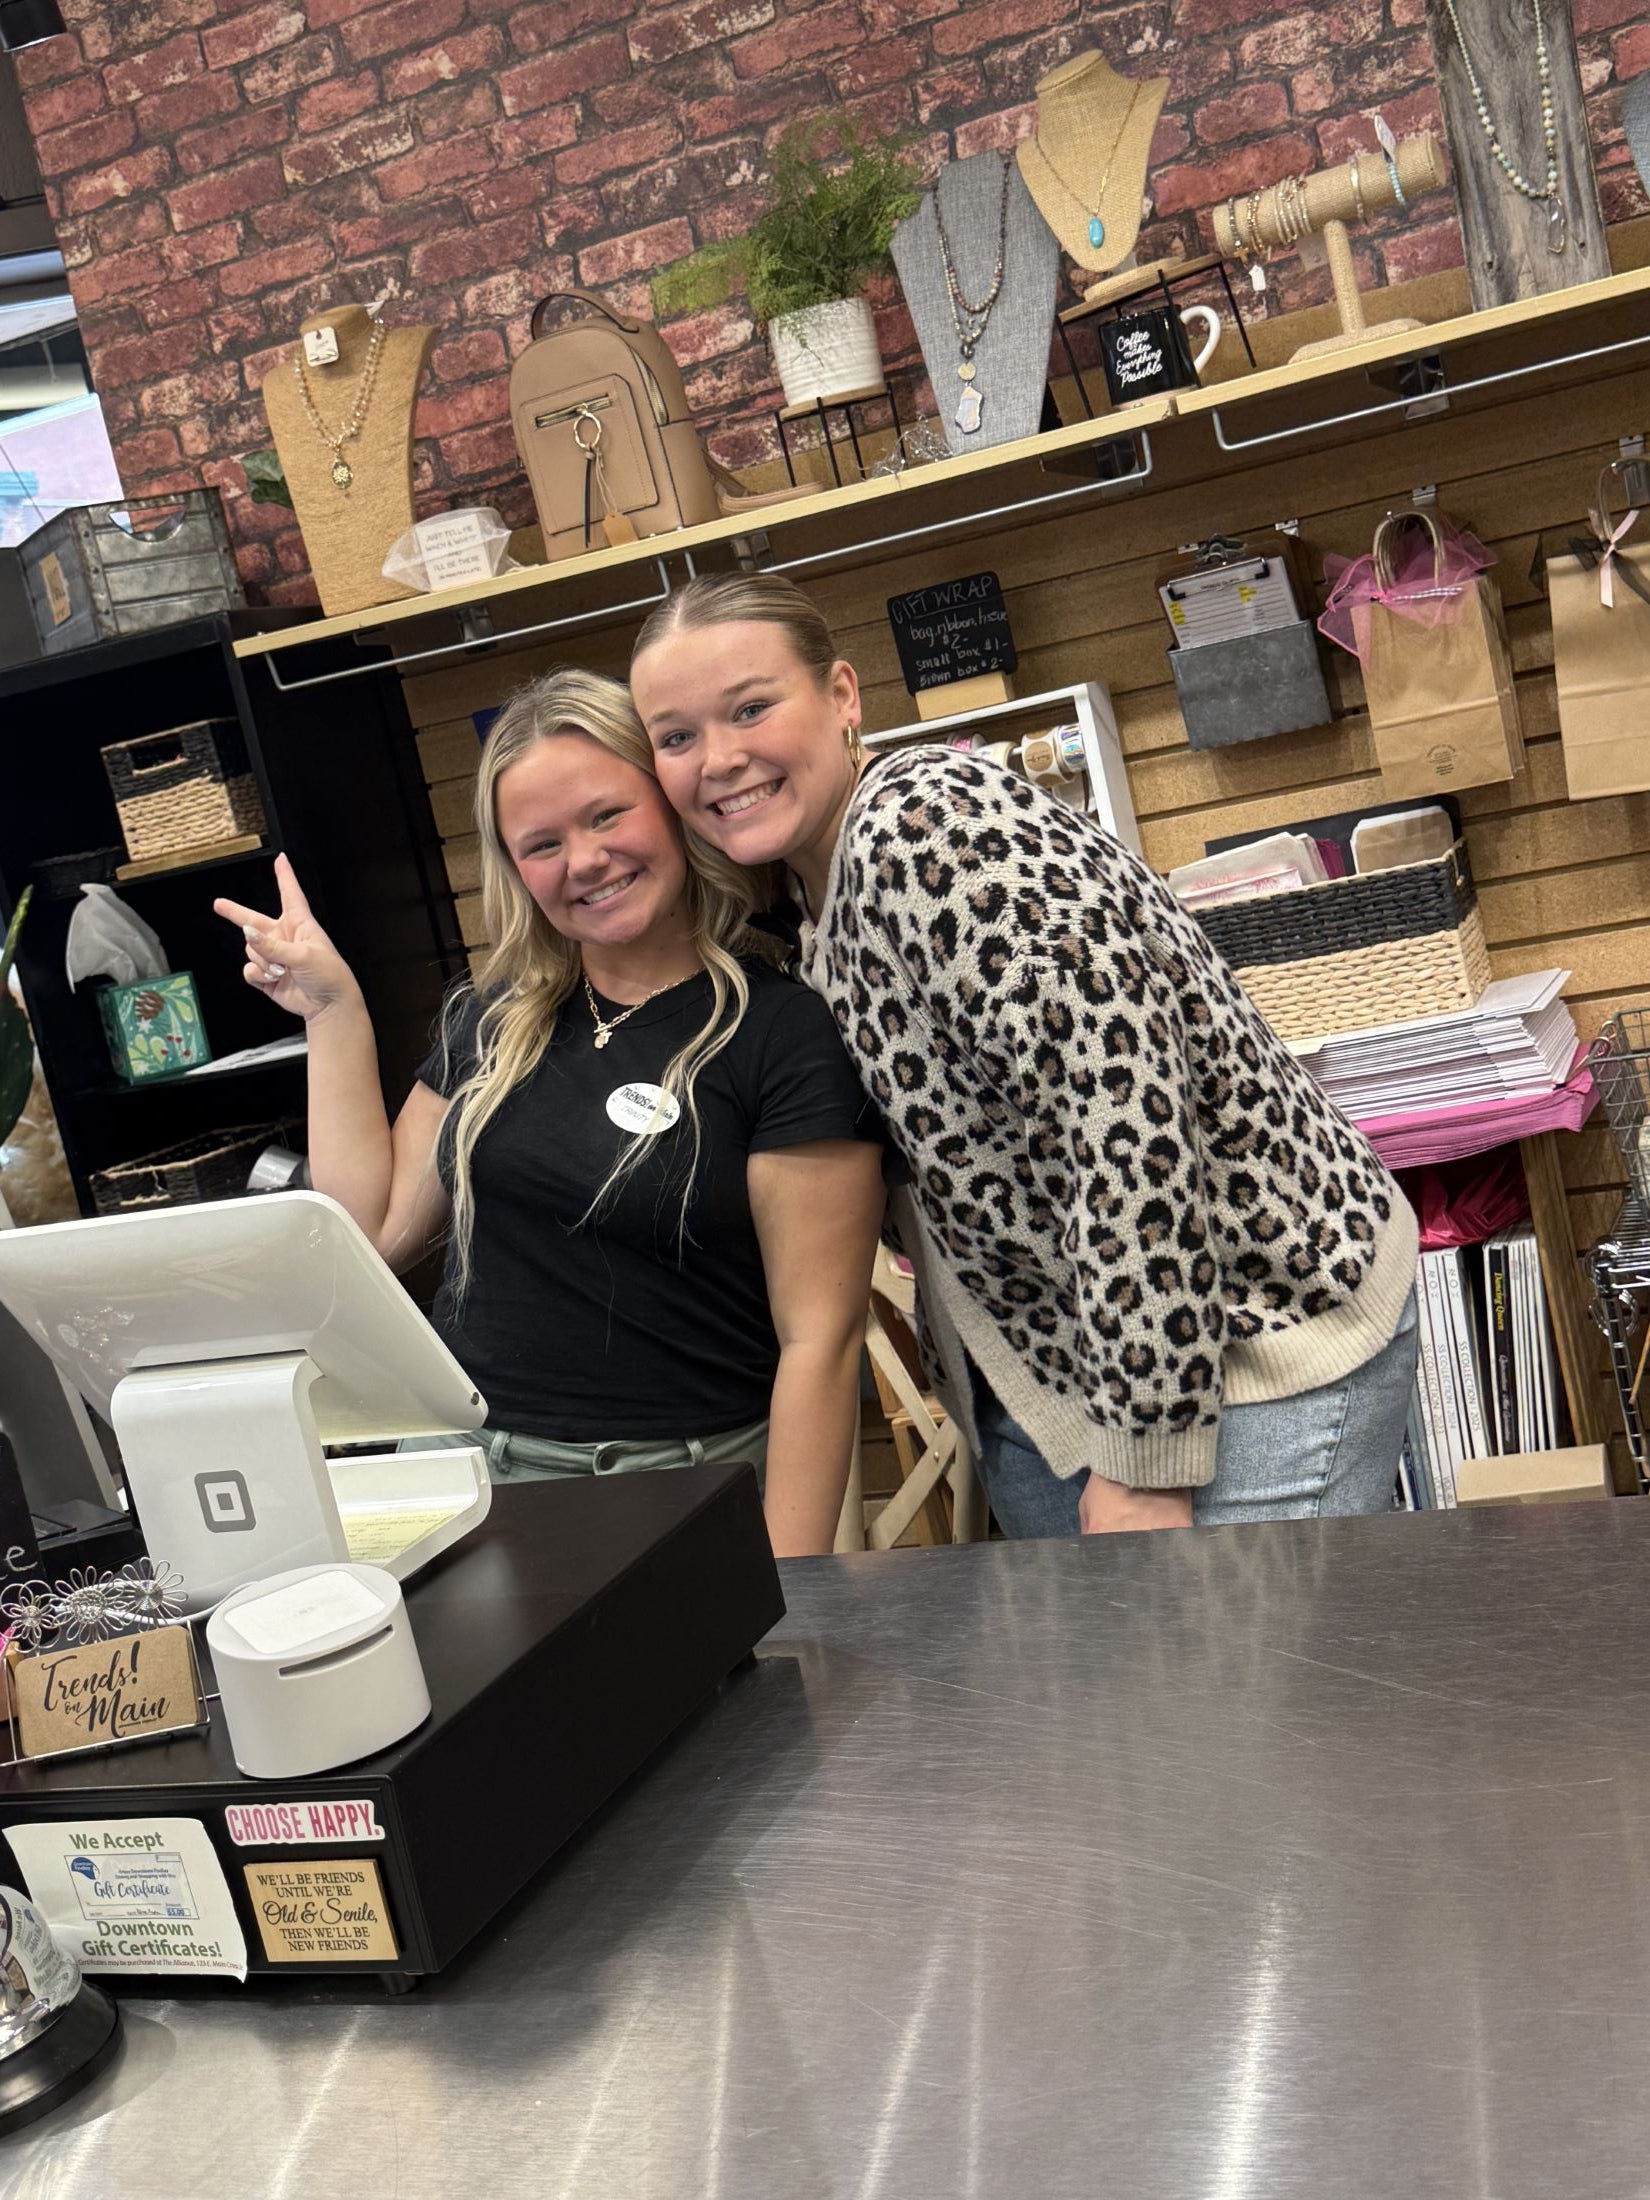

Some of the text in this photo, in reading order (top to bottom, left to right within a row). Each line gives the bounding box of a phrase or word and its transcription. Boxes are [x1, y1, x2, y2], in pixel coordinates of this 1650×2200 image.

[1116, 331, 1150, 352] Coffee
[1122, 363, 1163, 388] Possible
[892, 576, 992, 624] GIFT WRAP
[956, 648, 981, 660] box
[958, 664, 978, 677] box
[1424, 1354, 1440, 1410] COLLECTION
[1462, 1350, 1476, 1404] COLLECTION
[41, 1640, 141, 1712] Trends!
[64, 1694, 171, 1737] on Main
[228, 1804, 380, 1841] CHOOSE HAPPY.
[69, 1832, 164, 1851] We Accept
[257, 1872, 364, 1886] WE'LL BE FRIENDS
[94, 1880, 171, 1899] Gift Certificate
[276, 1885, 352, 1898] UNTIL WE'RE
[262, 1898, 378, 1926] Old & Senile,
[96, 1920, 194, 1937] Downtown
[280, 1926, 370, 1940] THEN WE'LL BE
[82, 1939, 223, 1958] Gift Certificates!
[288, 1940, 368, 1952] NEW FRIENDS
[108, 1960, 119, 1968] may
